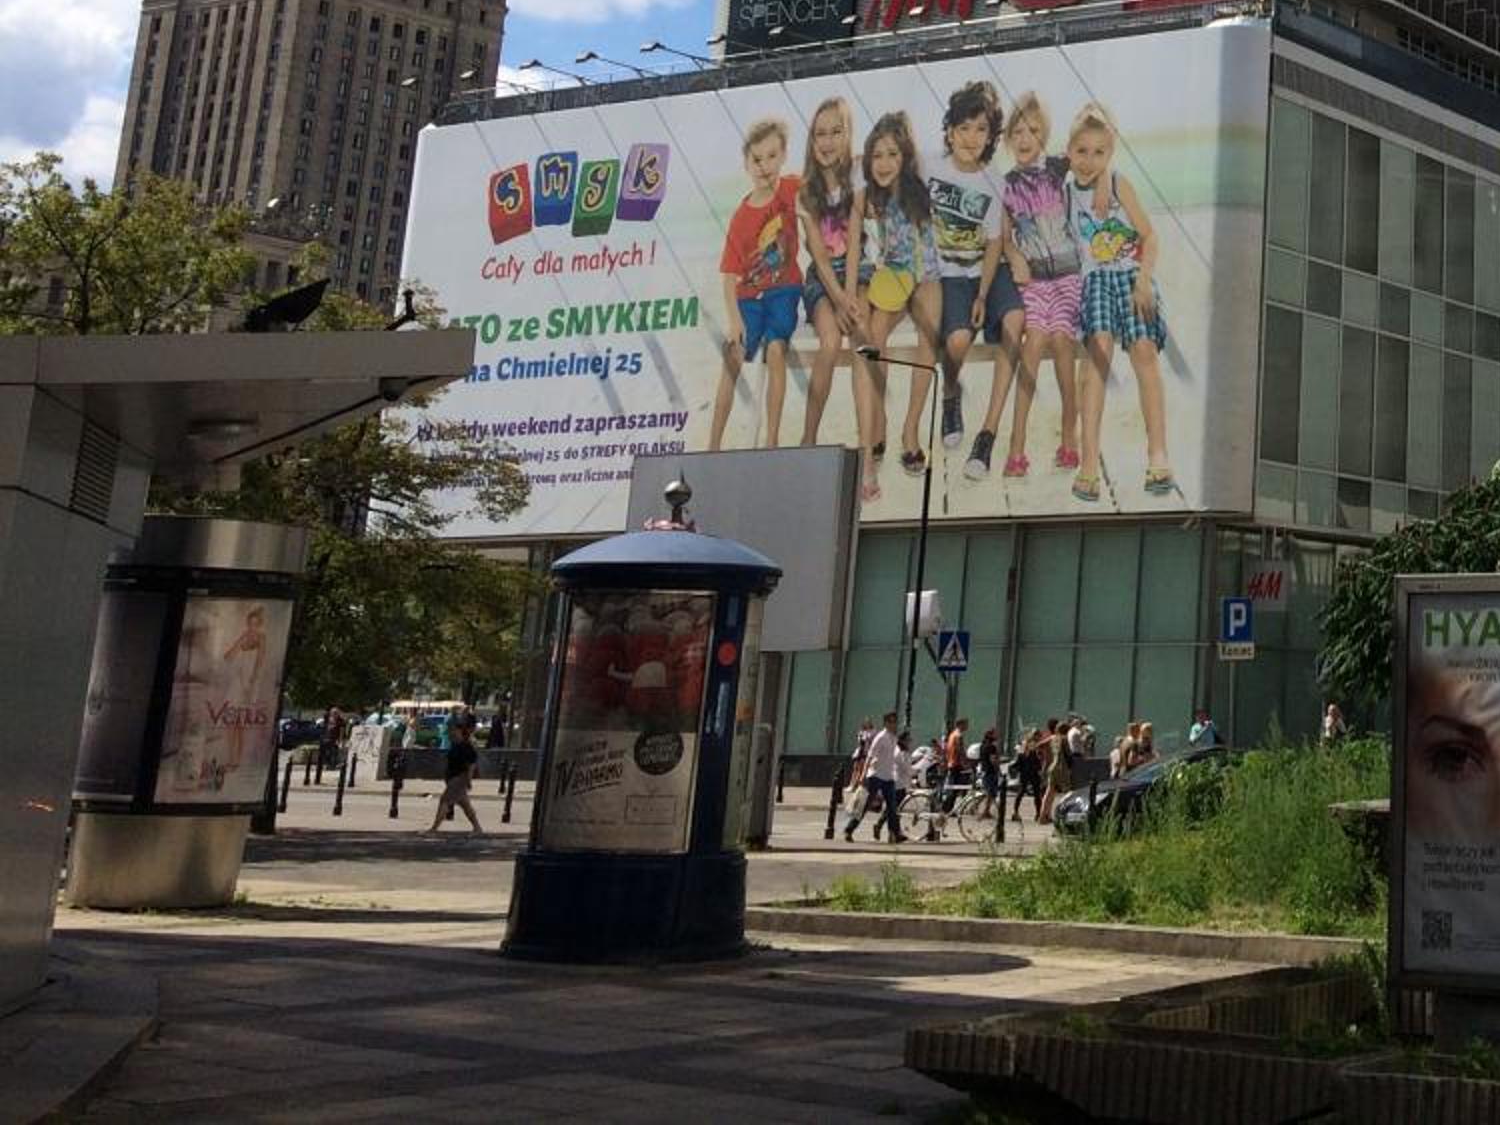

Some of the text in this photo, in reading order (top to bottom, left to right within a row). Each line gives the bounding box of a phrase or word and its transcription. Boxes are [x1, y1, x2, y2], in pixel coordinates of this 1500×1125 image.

[481, 253, 525, 284] Cały
[533, 250, 563, 276] dla
[571, 241, 643, 276] małych
[507, 316, 540, 343] ze
[545, 296, 700, 341] SMYKIEM
[497, 346, 612, 381] Chmielnej
[615, 352, 643, 375] 25
[491, 414, 572, 439] weekend
[575, 409, 689, 436] zapraszamy
[546, 449, 561, 463] 25
[564, 444, 580, 460] do
[582, 443, 627, 459] STREFY
[1229, 602, 1247, 636] P
